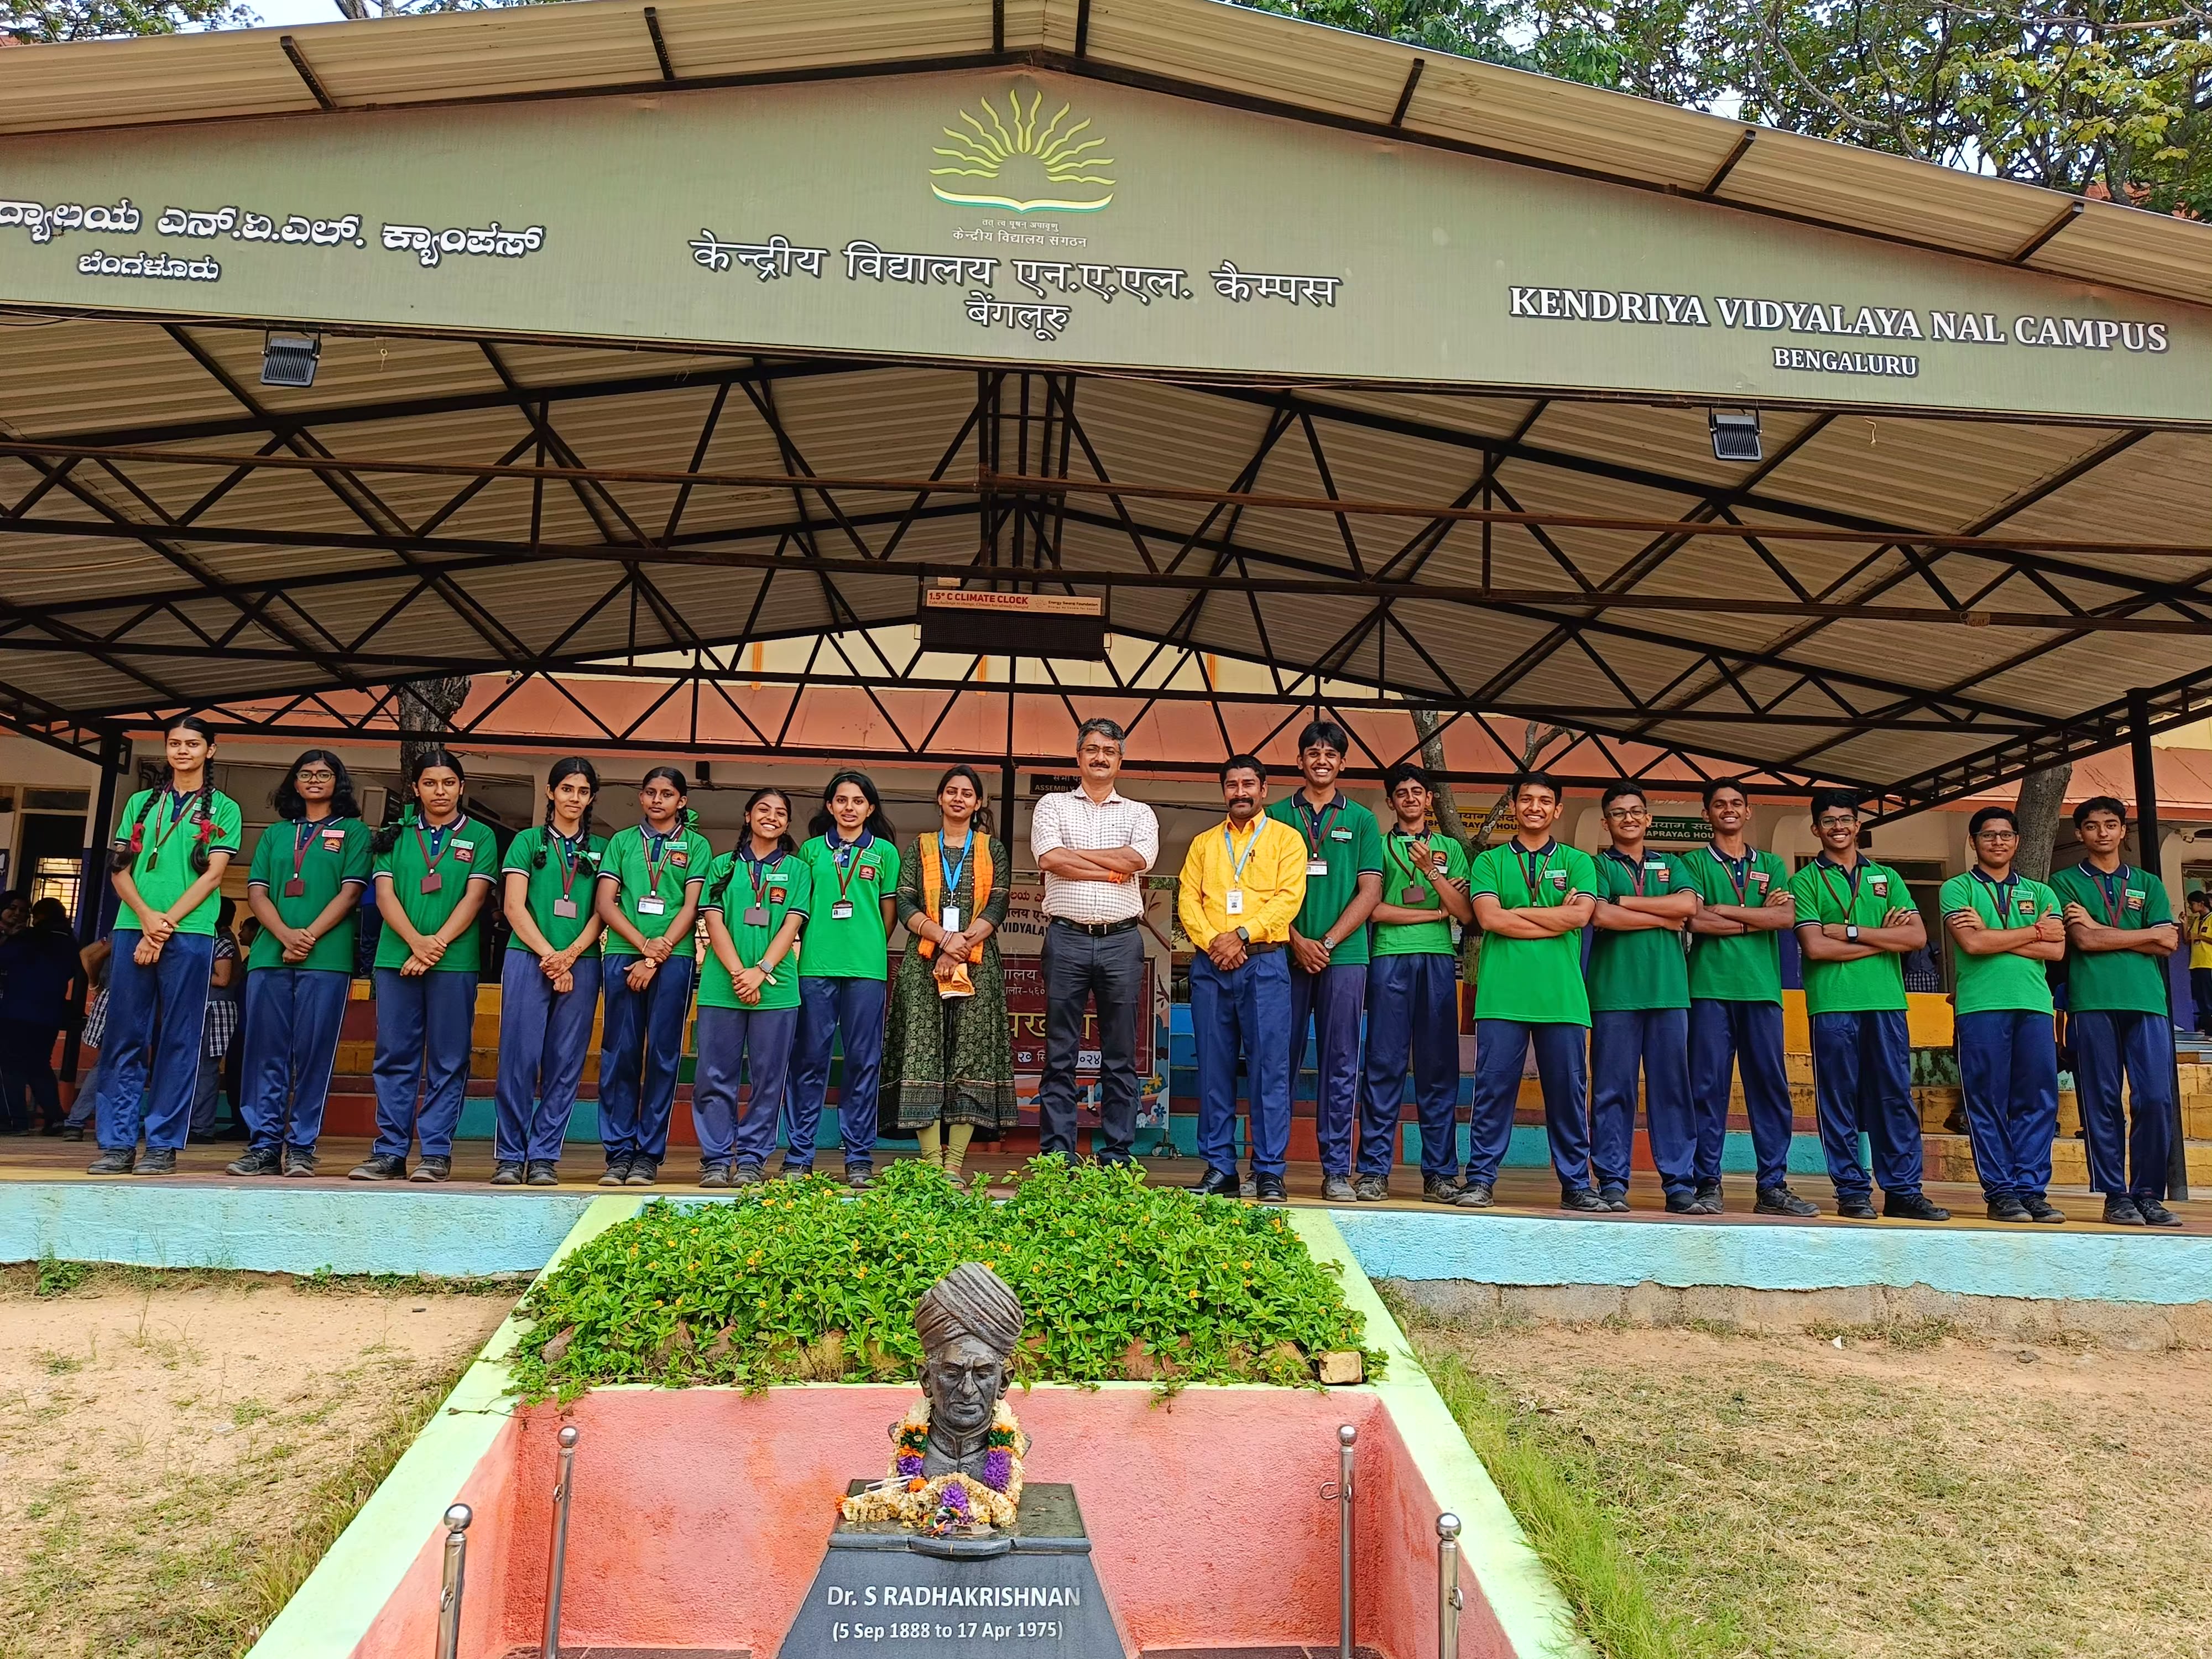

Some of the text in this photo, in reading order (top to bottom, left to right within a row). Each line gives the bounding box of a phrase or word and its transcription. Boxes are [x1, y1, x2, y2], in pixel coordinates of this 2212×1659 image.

[381, 222, 544, 266] ಕ್ಯಾಂಪಸ್
[952, 227, 1088, 248] केन्द्रीय विद्यालय संगठन
[78, 250, 221, 281] ಬೆಂಗಳೂರು
[688, 229, 1342, 307] केन्द्रीय विद्यालय एन.ए.एल. कैम्पस
[1509, 285, 2169, 353] KENDRIYA VIDYALAYA NAL CAMPUS
[1772, 346, 1918, 377] BENGALURU
[954, 593, 995, 603] CLIMATE
[997, 596, 1029, 604] CLOCK
[1003, 922, 1048, 936] VIDYALA
[1079, 1054, 1100, 1065] ०२४
[827, 1585, 1081, 1607] Dr. S RADHAKRISHNAN
[833, 1620, 1064, 1642] (5 Sep 1888 to 17 Apr 1975)
